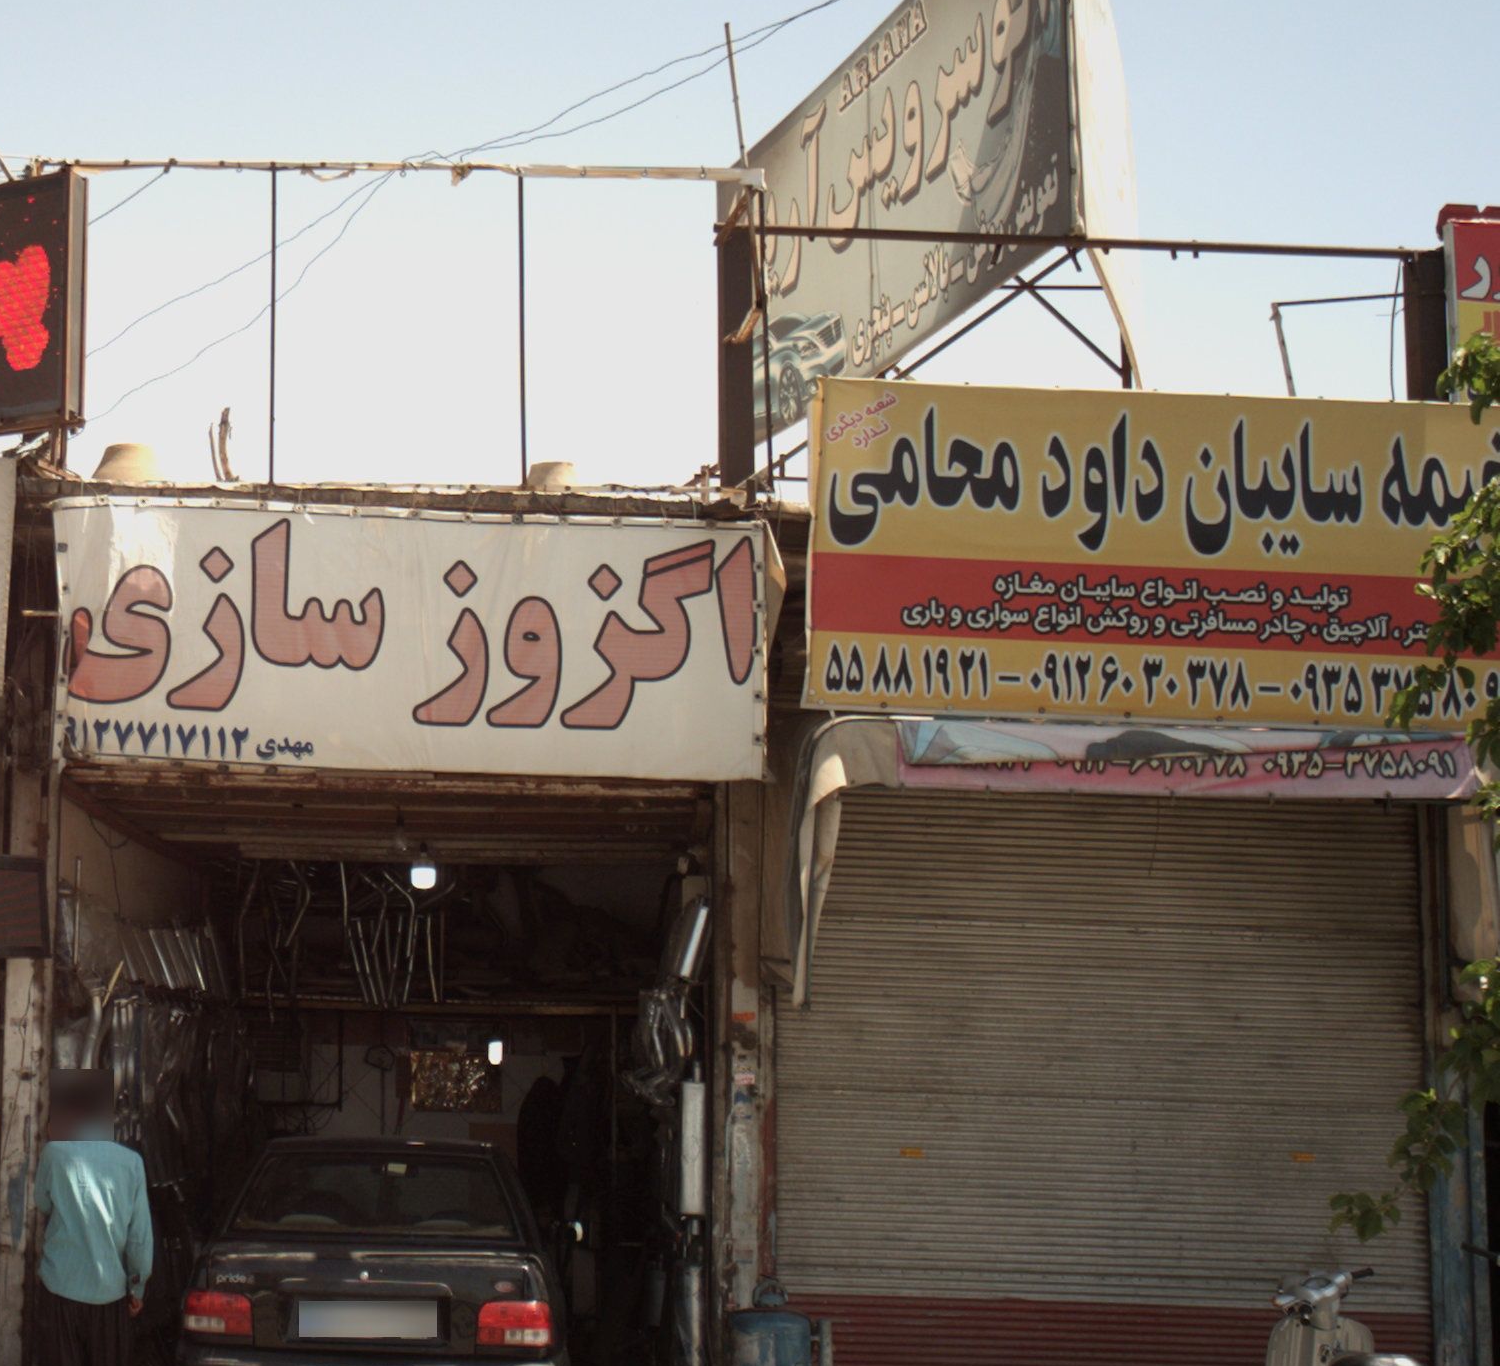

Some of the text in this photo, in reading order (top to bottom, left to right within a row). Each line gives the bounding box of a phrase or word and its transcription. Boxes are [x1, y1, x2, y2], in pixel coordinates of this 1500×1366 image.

[825, 393, 897, 442] شعبه دیگری
[853, 419, 890, 448] ندارد
[829, 407, 1019, 546] محامی
[1042, 412, 1165, 551] داود
[1186, 419, 1362, 556] سایبان
[994, 572, 1349, 612] تولید و نصب انواع سایبان مغازه
[67, 518, 756, 730] اگزوز سازی
[902, 598, 946, 626] باری
[950, 609, 963, 628] و
[966, 601, 1030, 629] سواری
[1033, 605, 1082, 632] انواع
[1086, 605, 1149, 635] روکش
[1153, 617, 1166, 636] و
[1170, 611, 1257, 638] مسافرتی
[1260, 613, 1307, 643] چادر
[255, 737, 314, 761] مهدی
